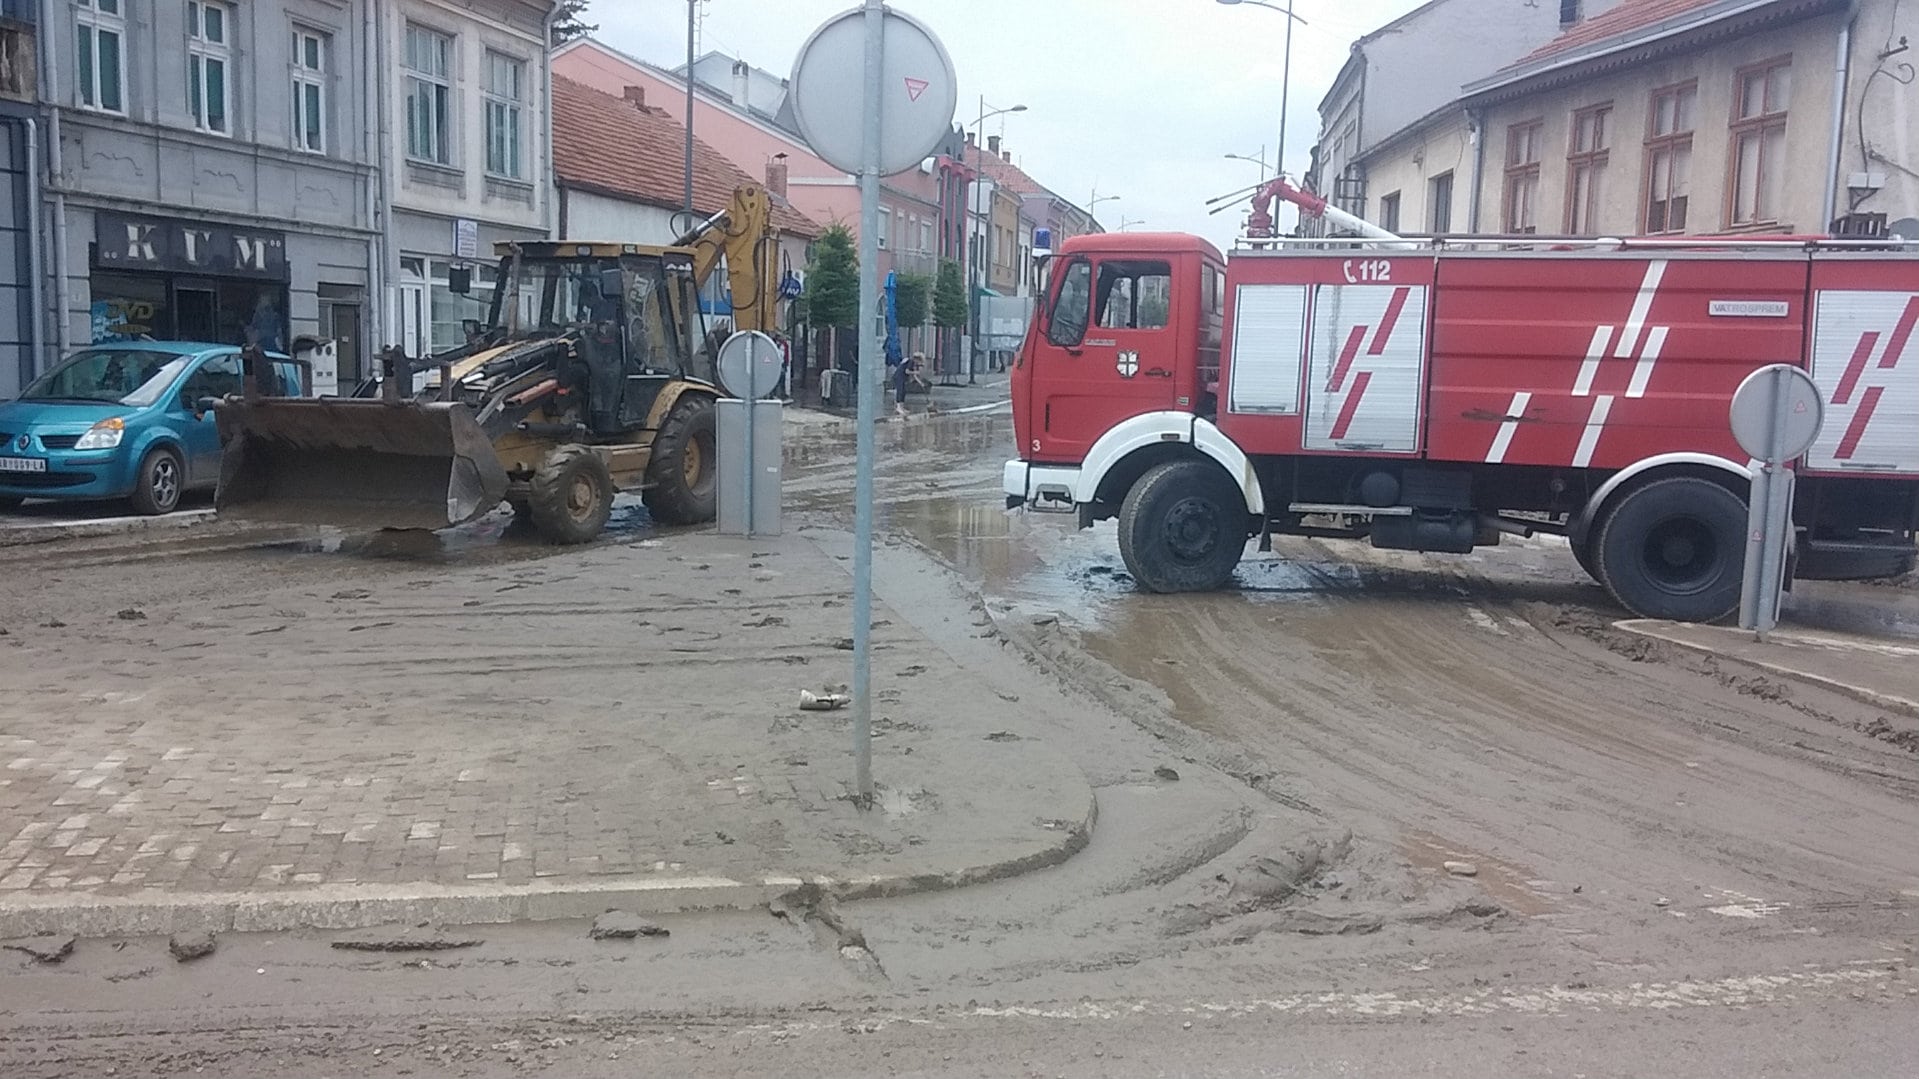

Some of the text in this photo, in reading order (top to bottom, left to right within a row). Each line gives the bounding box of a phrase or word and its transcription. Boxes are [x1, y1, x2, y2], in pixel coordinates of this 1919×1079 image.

[1359, 260, 1391, 281] 112
[1712, 303, 1786, 315] VATROSPREM
[1031, 439, 1041, 452] 3
